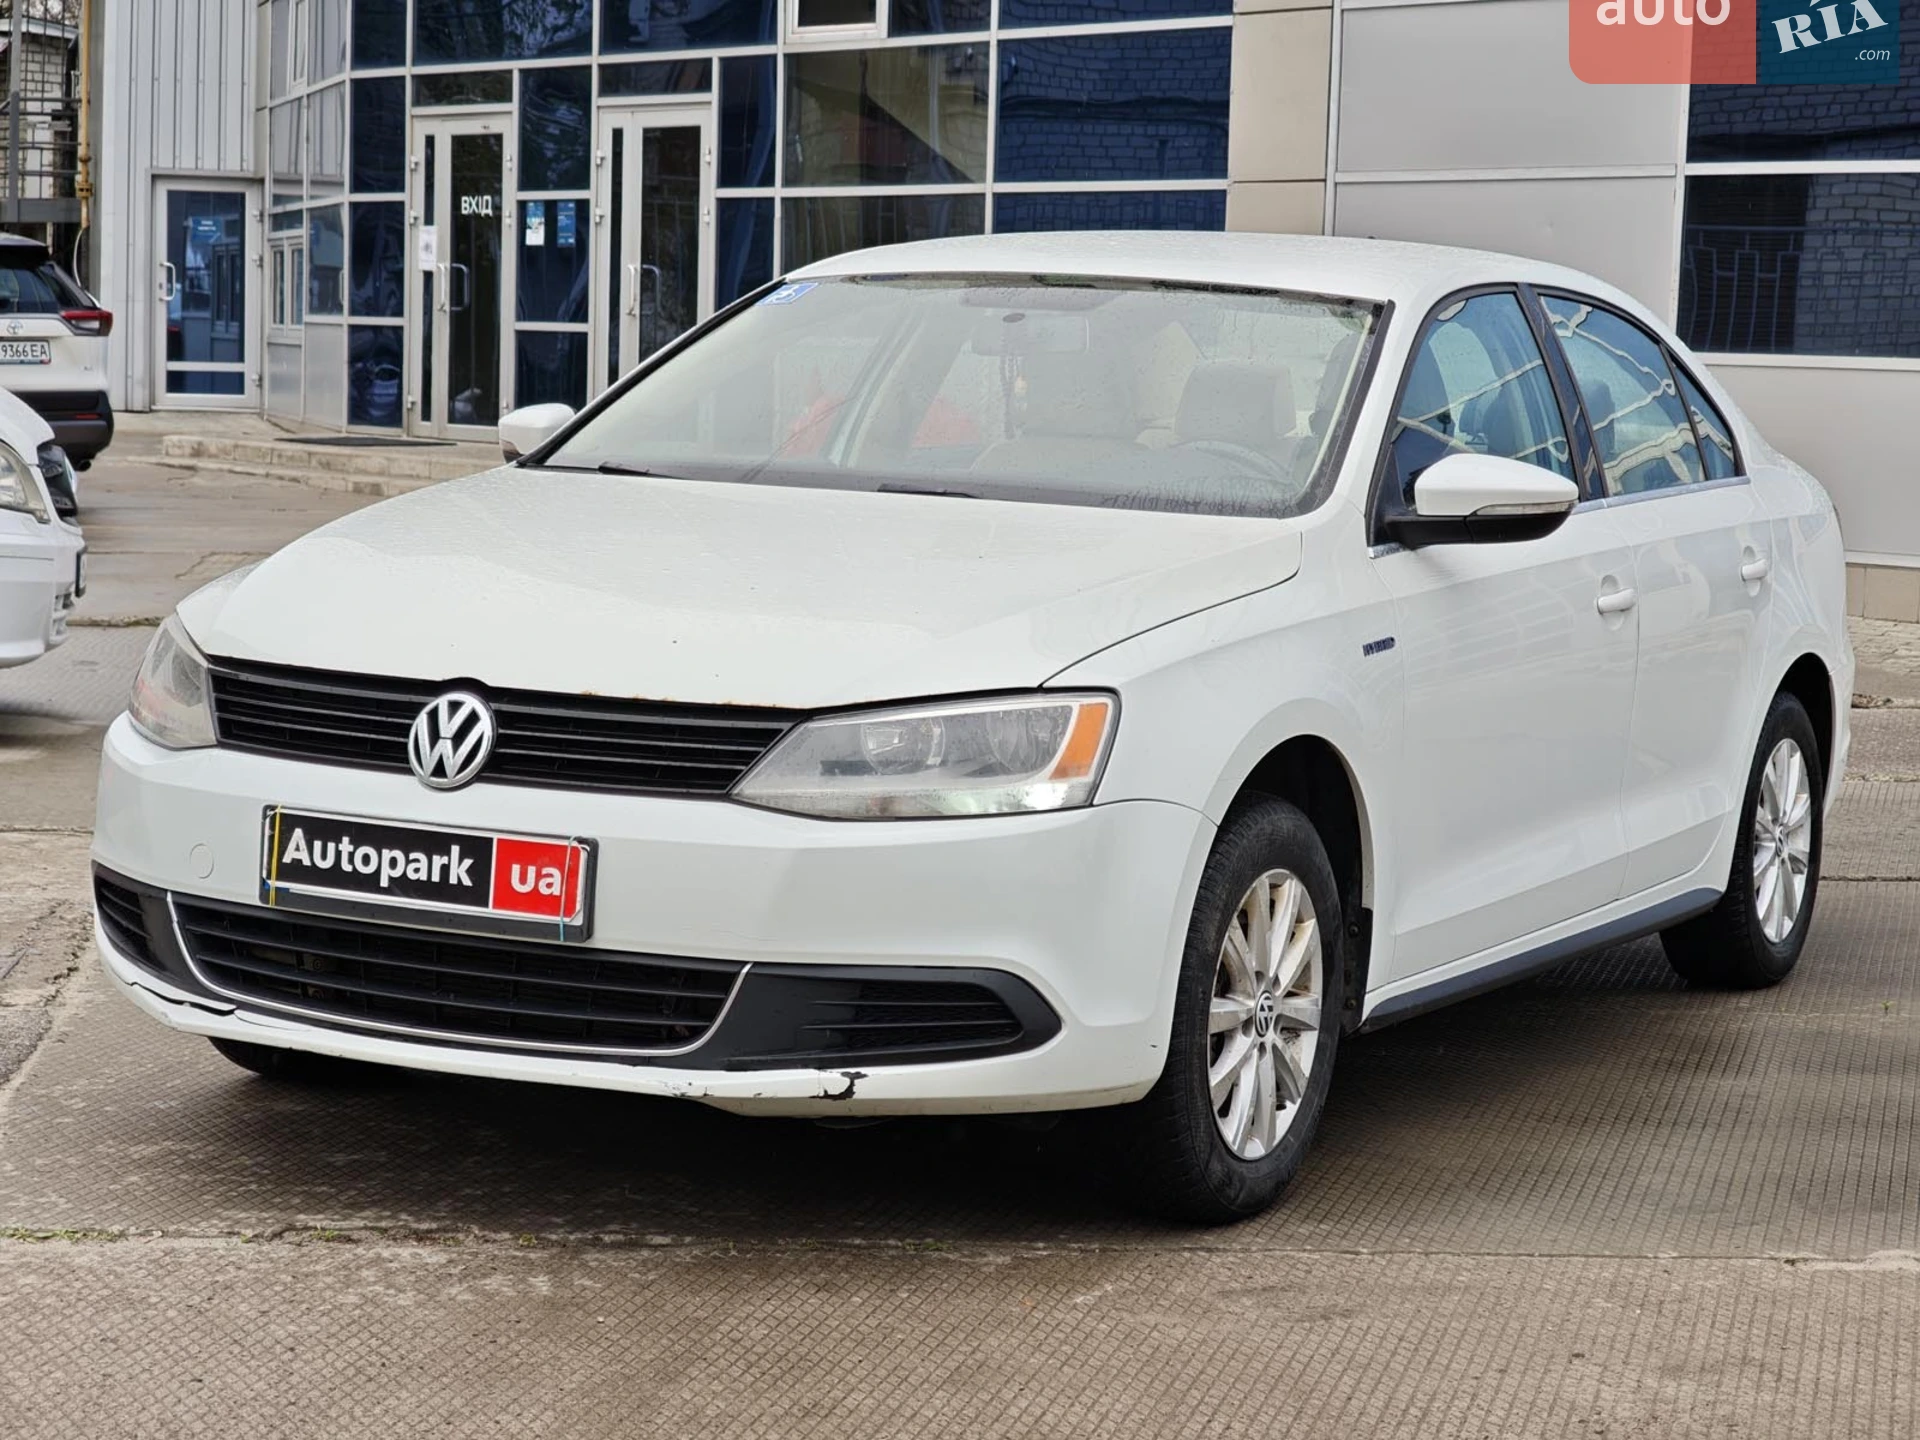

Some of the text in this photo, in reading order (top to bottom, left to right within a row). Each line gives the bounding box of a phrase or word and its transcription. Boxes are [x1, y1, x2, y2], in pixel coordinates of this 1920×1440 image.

[461, 195, 493, 217] ВХІД
[282, 828, 563, 896] Autopark ua
